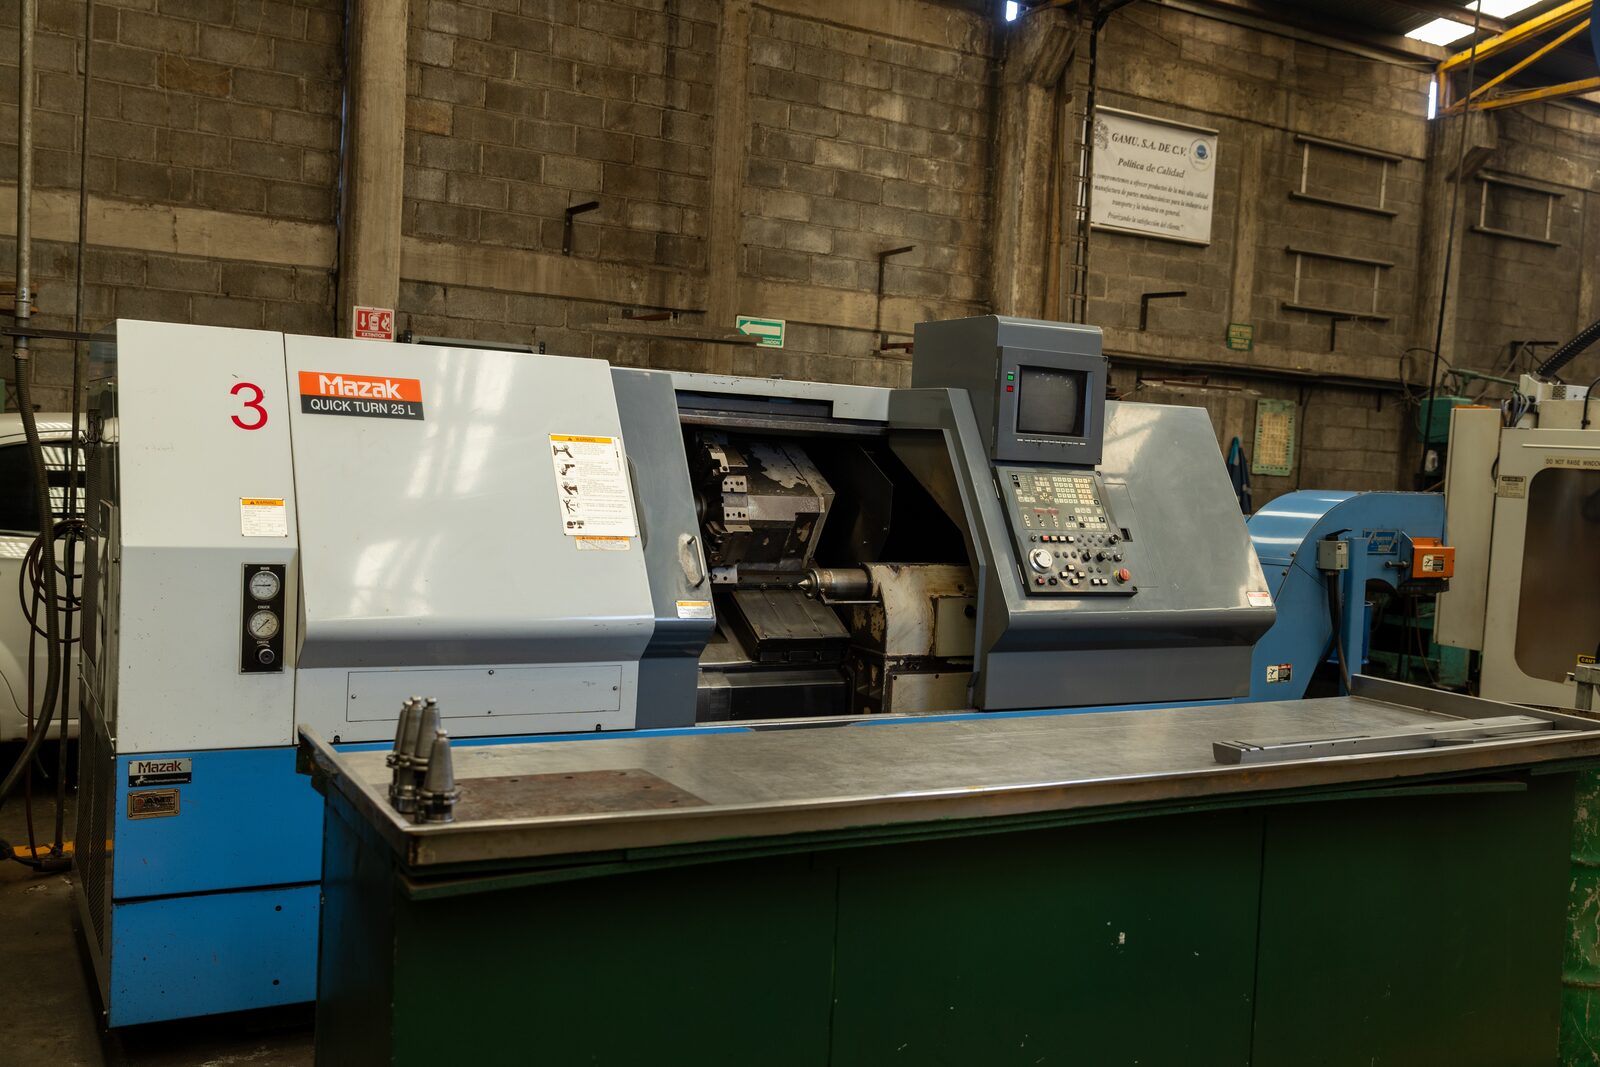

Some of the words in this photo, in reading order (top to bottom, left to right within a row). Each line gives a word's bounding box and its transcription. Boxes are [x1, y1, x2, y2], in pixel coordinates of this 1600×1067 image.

[1141, 139, 1156, 151] S.A.
[1158, 142, 1170, 153] DE
[1172, 145, 1187, 157] C.V.
[1117, 157, 1145, 171] Política
[1146, 163, 1156, 173] de
[1156, 166, 1186, 178] Calidad
[318, 374, 403, 400] Mazak
[230, 382, 268, 430] 3
[310, 398, 352, 412] QUICK
[353, 401, 388, 414] TURN
[391, 404, 405, 415] 25
[408, 405, 416, 416] L
[138, 761, 182, 774] Mazak
